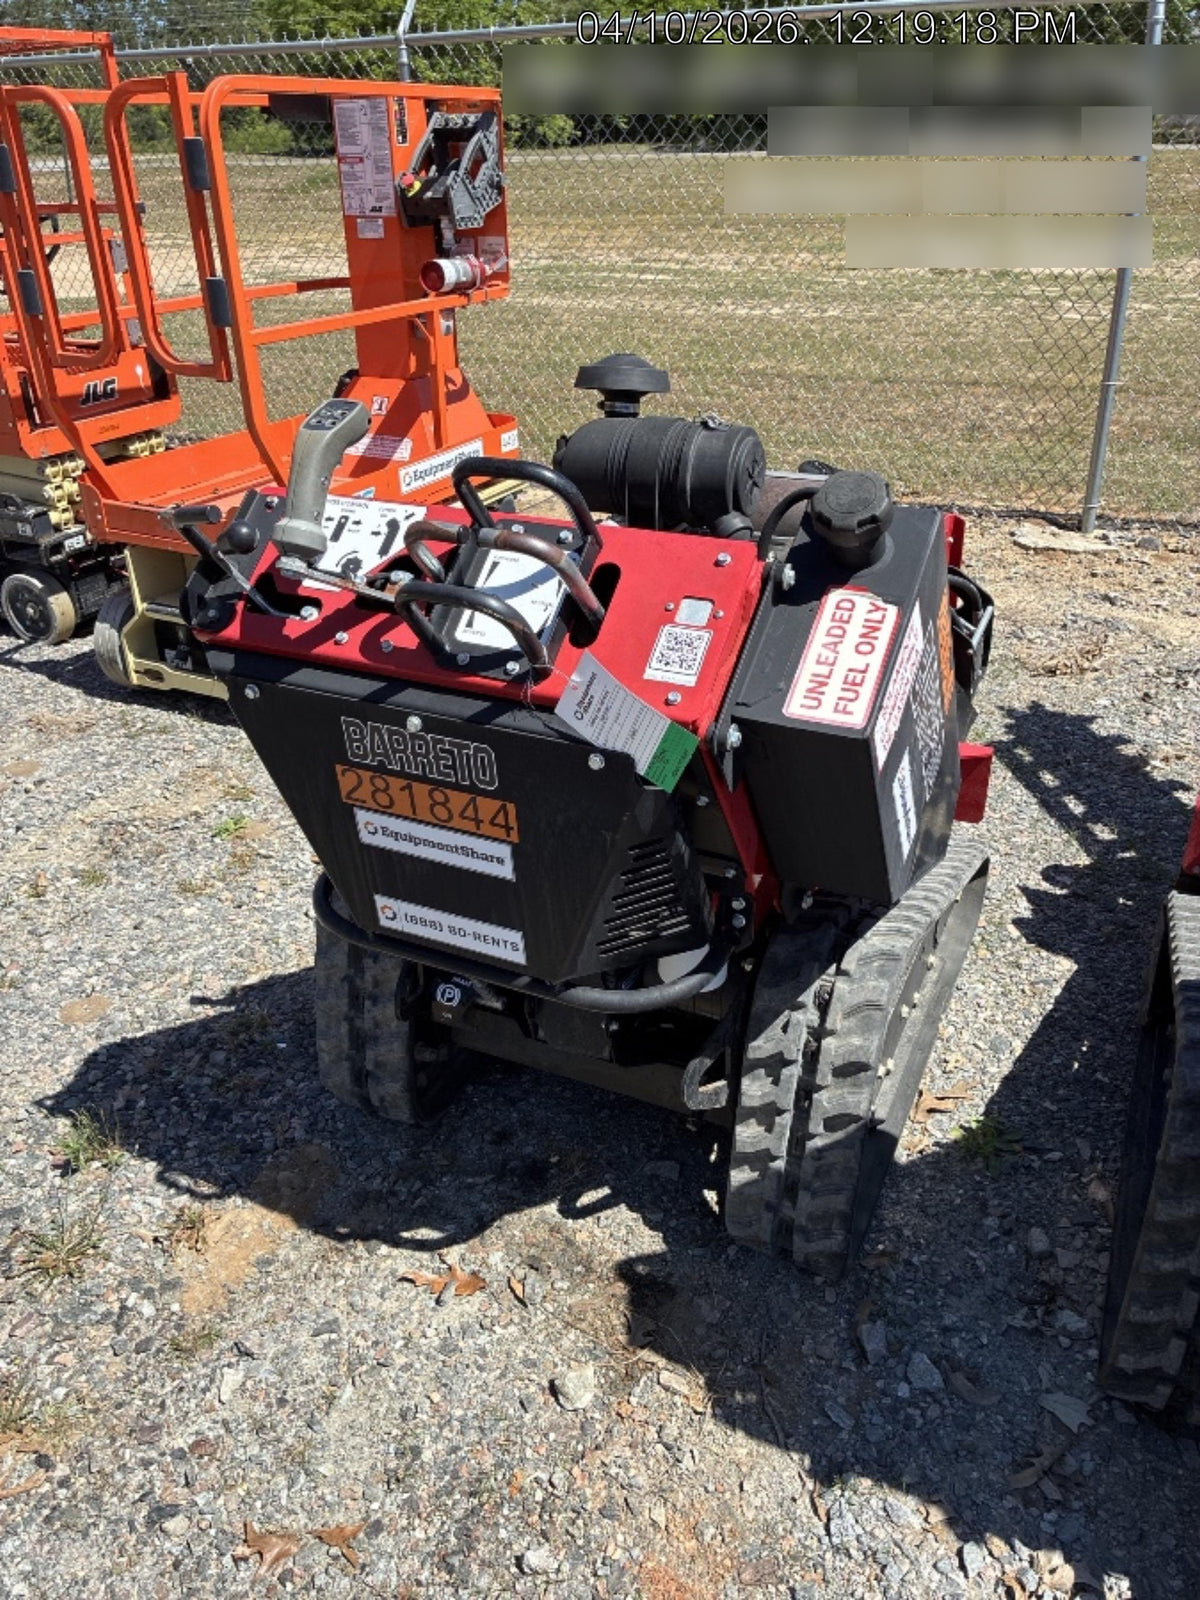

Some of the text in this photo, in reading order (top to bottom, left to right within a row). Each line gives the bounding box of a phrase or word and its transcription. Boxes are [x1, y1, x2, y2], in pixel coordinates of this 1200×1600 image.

[80, 377, 118, 407] JLG
[800, 598, 856, 709] UNLEADED
[833, 601, 888, 715] FUEL ONLY
[341, 716, 498, 790] BARRETO
[341, 767, 515, 838] 281844
[380, 825, 506, 866] EquipmentShare
